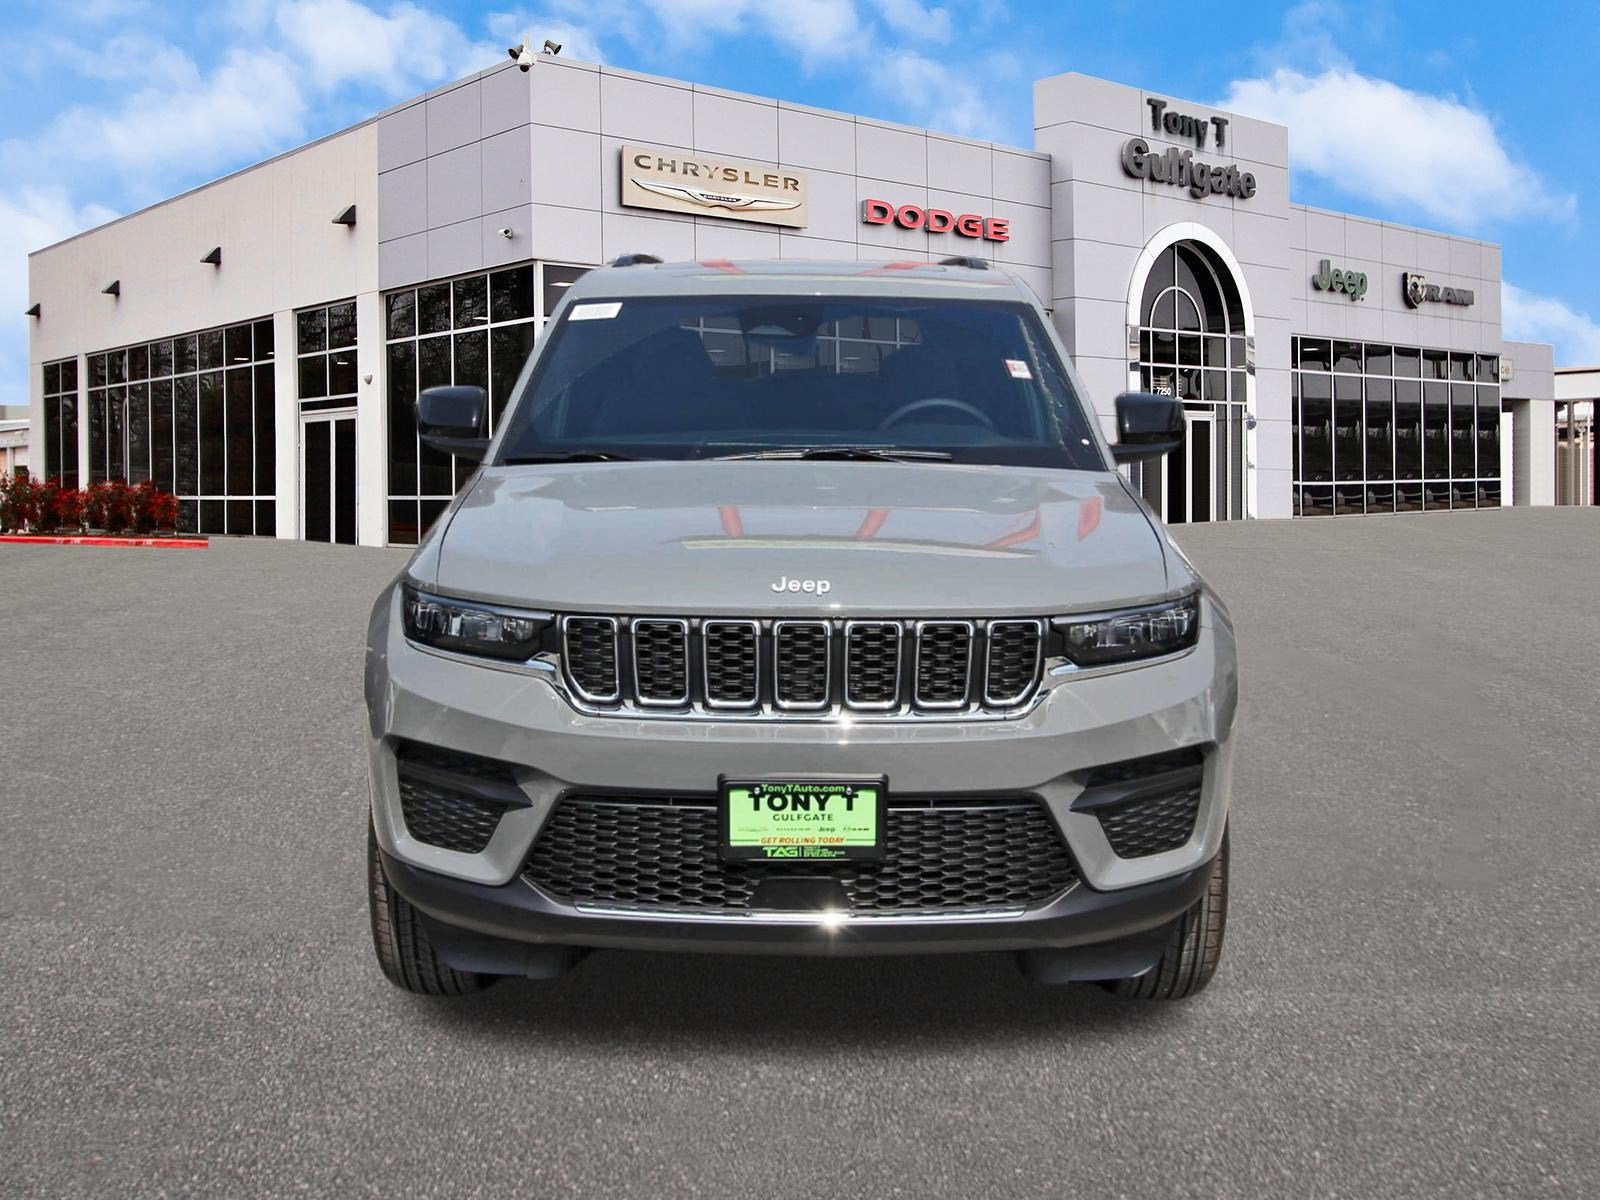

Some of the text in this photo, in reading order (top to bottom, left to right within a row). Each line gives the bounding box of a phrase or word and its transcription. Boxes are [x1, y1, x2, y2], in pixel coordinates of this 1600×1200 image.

[1147, 97, 1229, 148] Tony T
[633, 154, 800, 192] CHRYSLER
[1121, 137, 1256, 199] Gulfgate
[862, 198, 1010, 242] DODGE
[1312, 259, 1368, 302] Jeep
[1425, 283, 1475, 307] RAM
[771, 576, 831, 596] Jeep
[761, 784, 845, 794] TonyTAuto.com
[748, 793, 859, 811] TONY T
[773, 813, 834, 822] GULFGATE
[818, 836, 845, 844] TODAY
[762, 847, 798, 857] TAG
